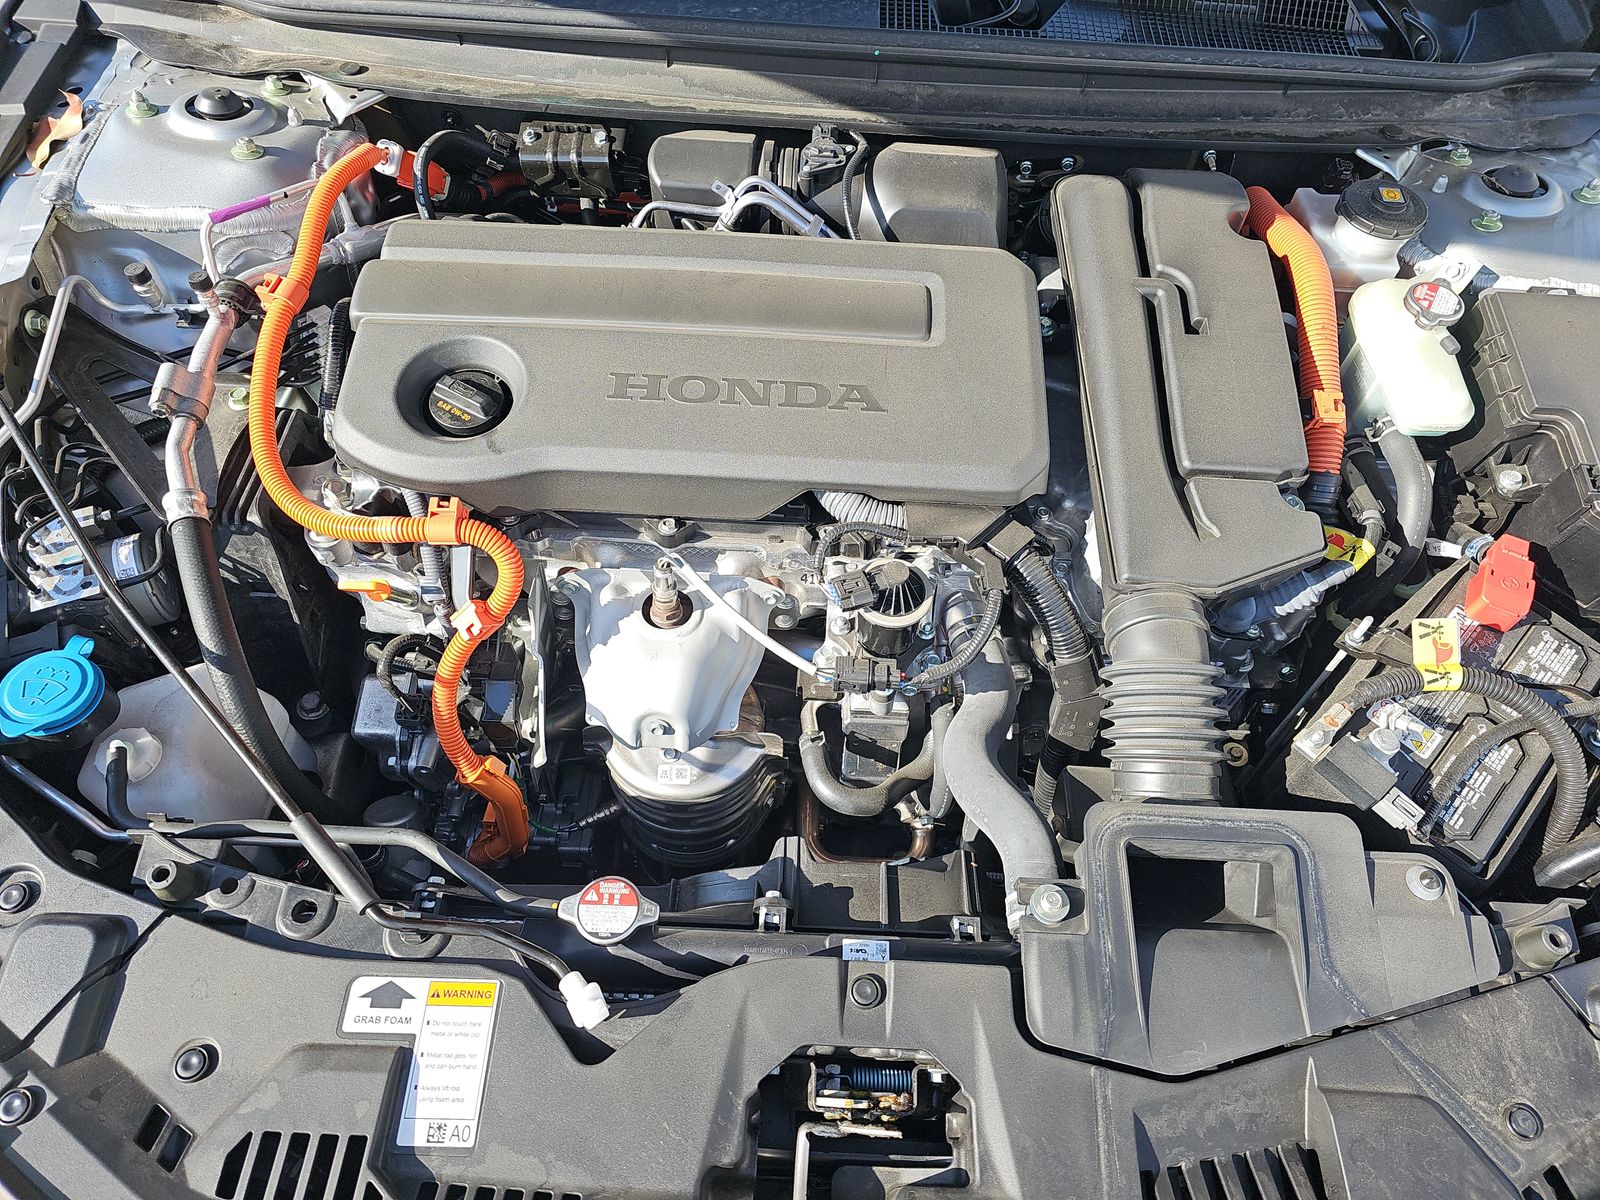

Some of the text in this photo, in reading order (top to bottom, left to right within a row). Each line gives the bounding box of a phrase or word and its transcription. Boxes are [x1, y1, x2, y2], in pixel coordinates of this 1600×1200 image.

[606, 373, 888, 413] HONDA
[437, 400, 471, 421] SAE 0W-20
[443, 989, 492, 999] WARNING
[353, 1015, 412, 1025] GRAB FOAM
[449, 1125, 471, 1143] A0
